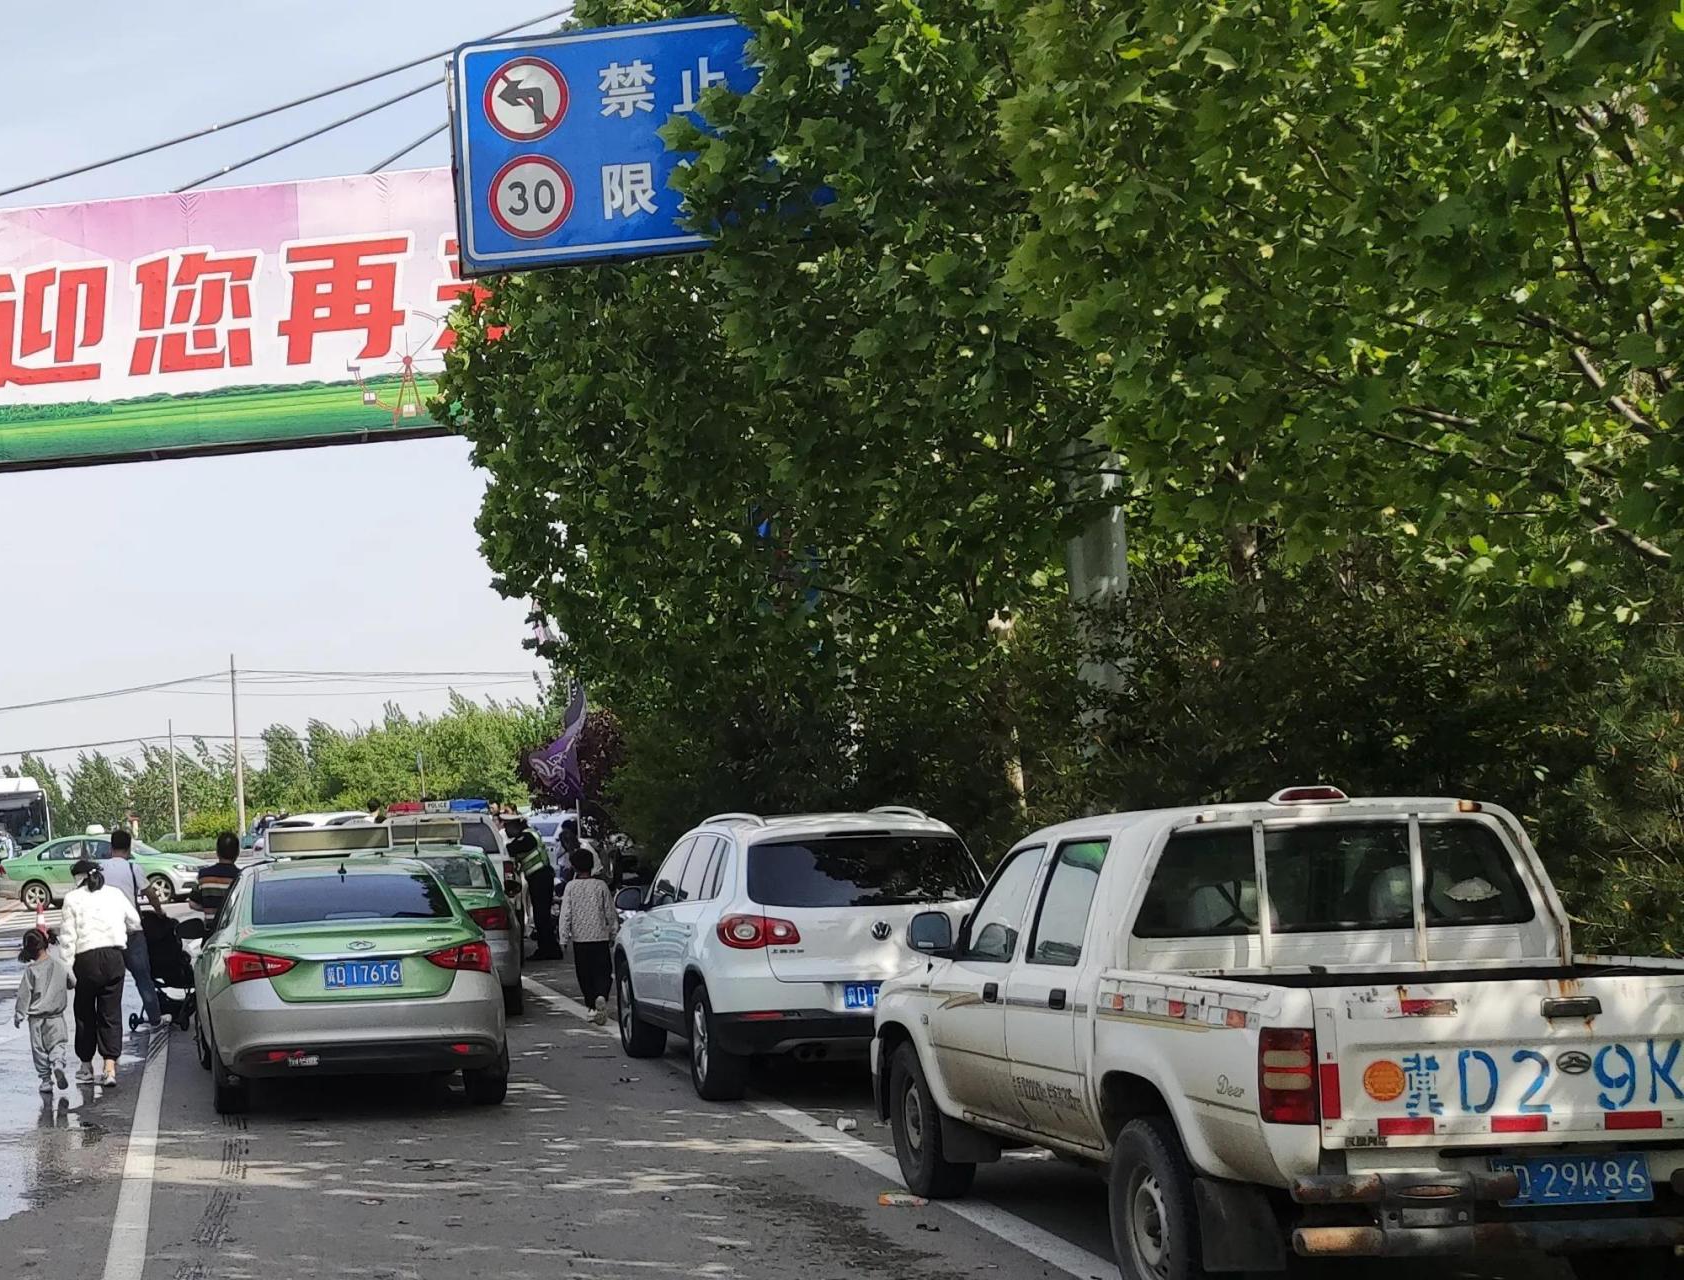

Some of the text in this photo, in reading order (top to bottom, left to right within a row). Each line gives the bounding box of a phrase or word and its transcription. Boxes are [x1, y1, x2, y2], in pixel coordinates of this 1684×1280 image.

[508, 179, 556, 217] 30
[601, 158, 696, 221] 限
[1216, 1074, 1245, 1098] Deer
[1492, 1159, 1647, 1198] D·29K86
